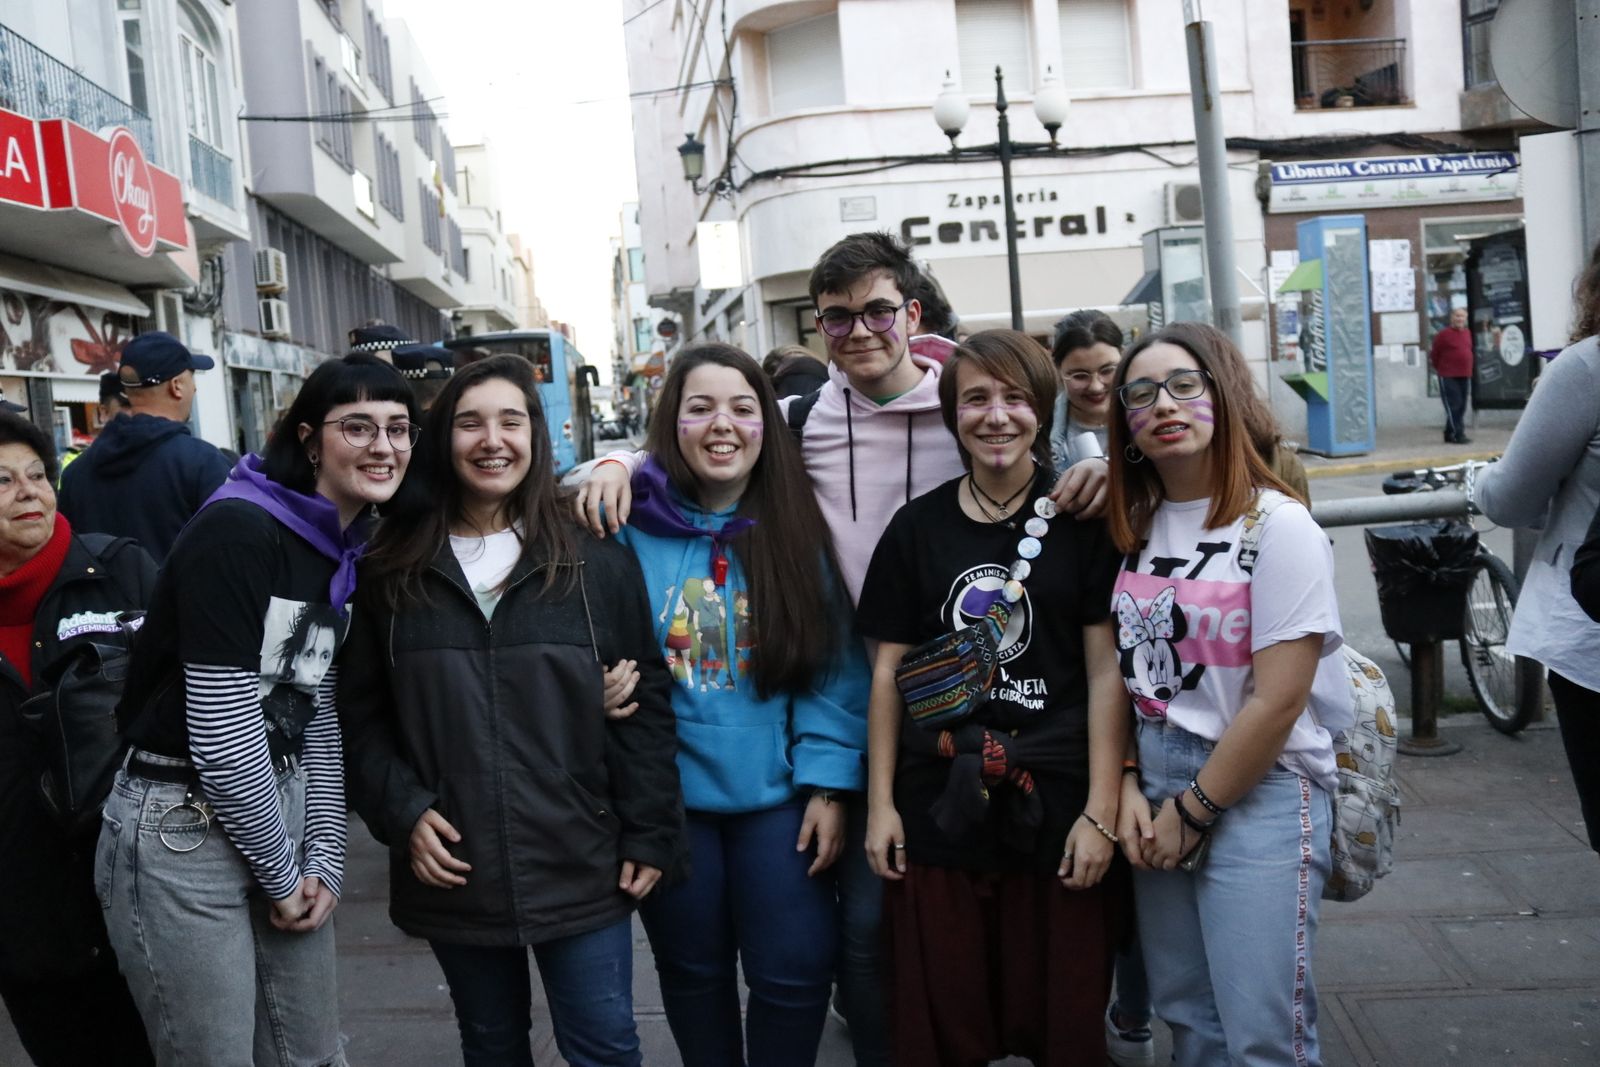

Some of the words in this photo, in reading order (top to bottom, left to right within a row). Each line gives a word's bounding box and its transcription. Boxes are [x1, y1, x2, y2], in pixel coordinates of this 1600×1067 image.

[114, 151, 153, 234] Okay
[59, 612, 119, 633] Adelant
[59, 627, 77, 640] LAS
